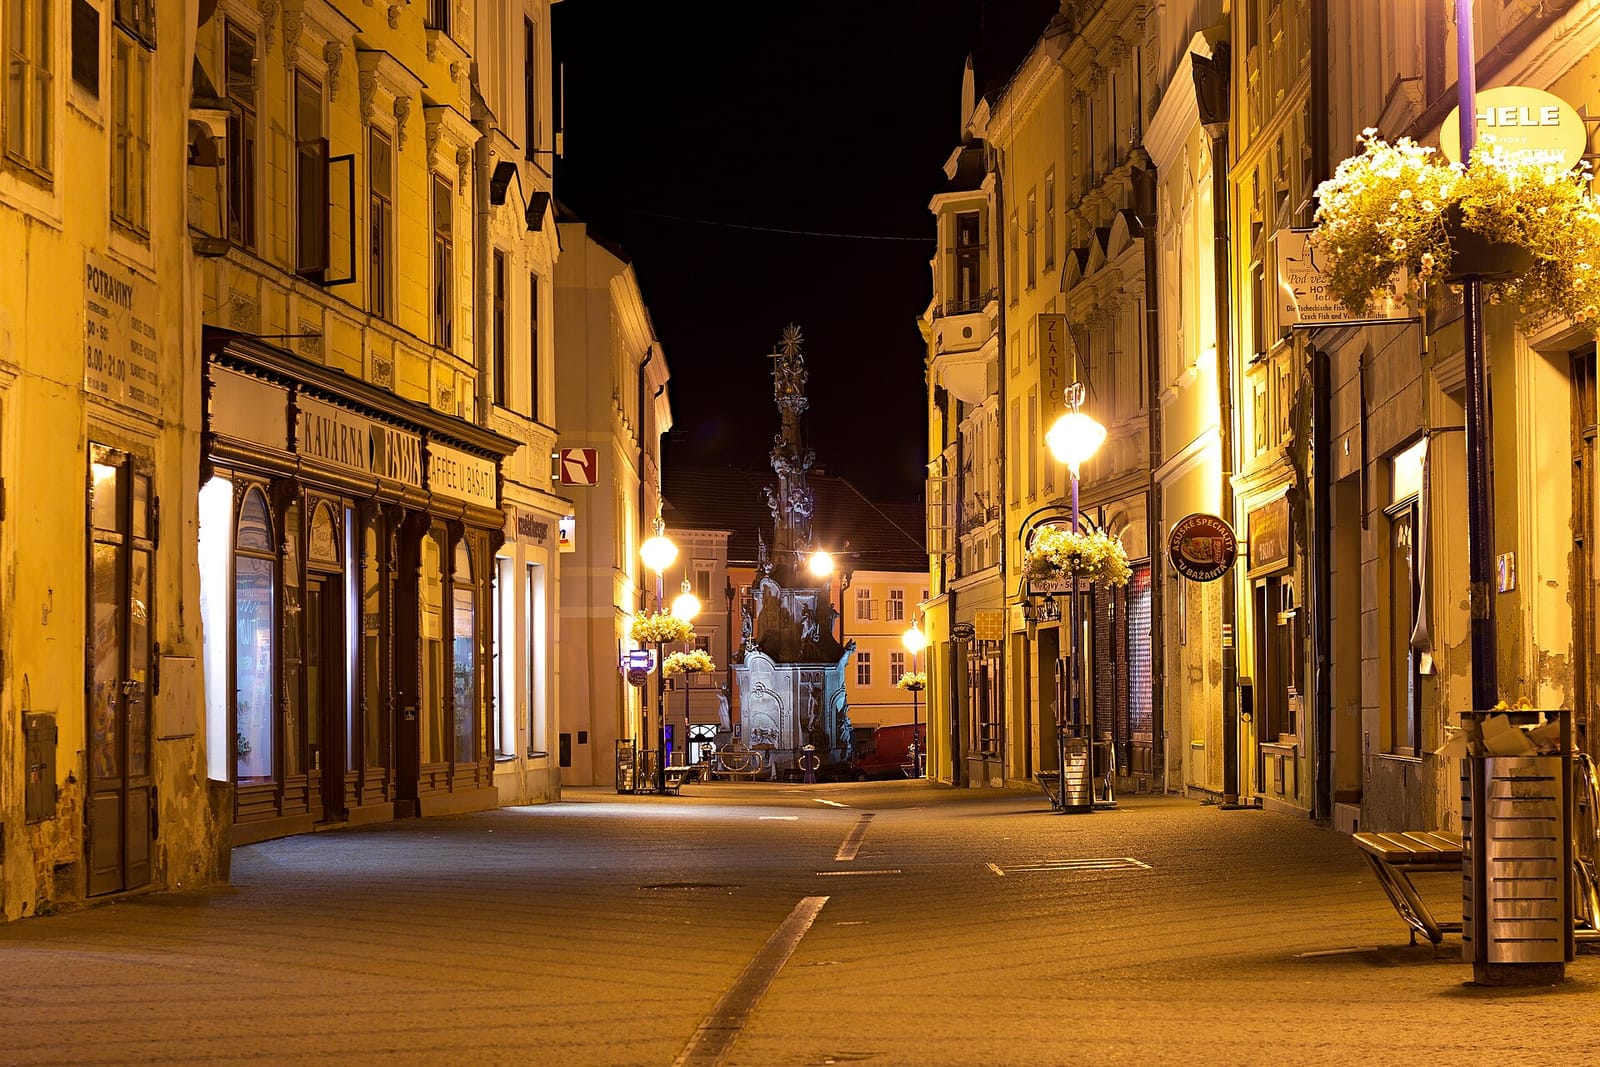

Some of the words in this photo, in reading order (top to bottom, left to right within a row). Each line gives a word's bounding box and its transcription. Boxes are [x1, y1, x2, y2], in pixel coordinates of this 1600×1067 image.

[86, 263, 133, 310] POTRAVINY
[1288, 274, 1307, 284] Pod
[304, 410, 364, 469] KAVÁRNA
[431, 455, 457, 489] AFFEE
[1196, 518, 1233, 552] SPECIALITY
